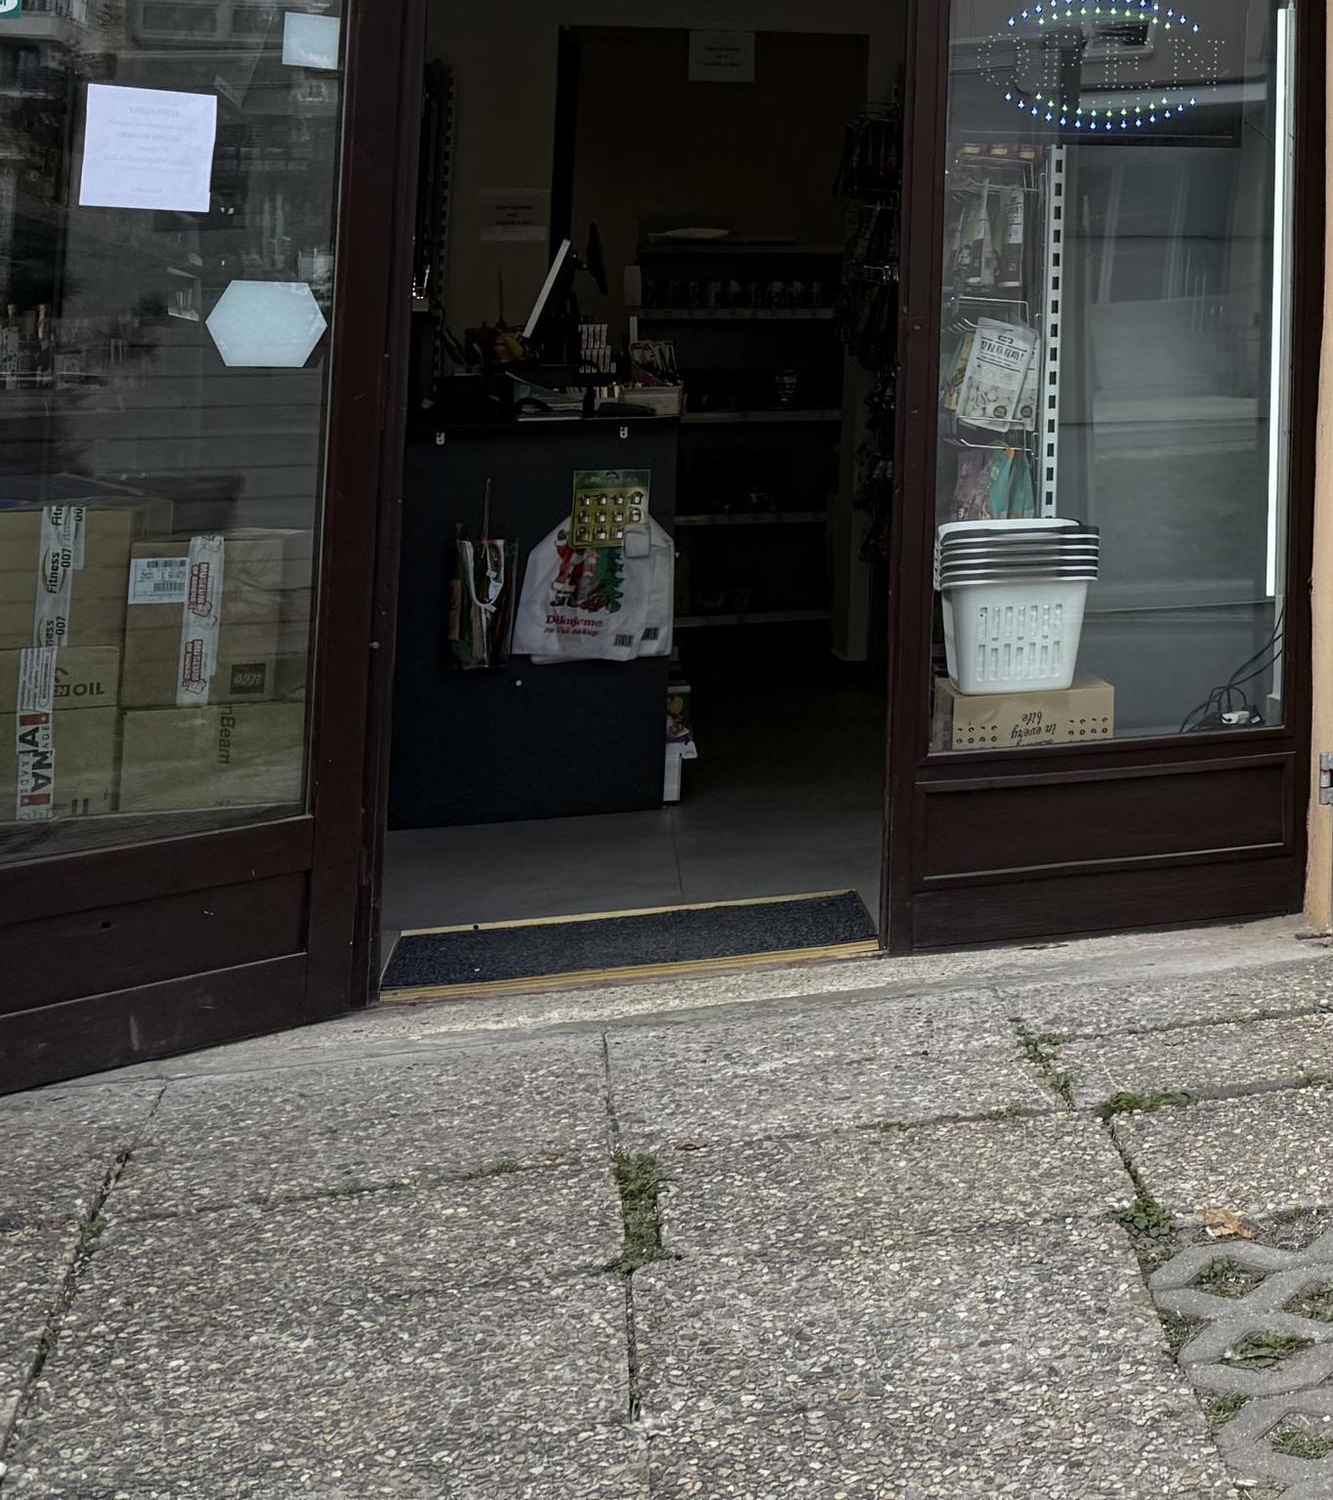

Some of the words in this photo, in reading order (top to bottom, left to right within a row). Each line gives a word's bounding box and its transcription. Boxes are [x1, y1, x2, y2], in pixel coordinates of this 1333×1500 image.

[61, 548, 71, 568] 007
[47, 551, 61, 595] Fitness
[55, 616, 66, 636] 007
[1022, 710, 1043, 722] bite
